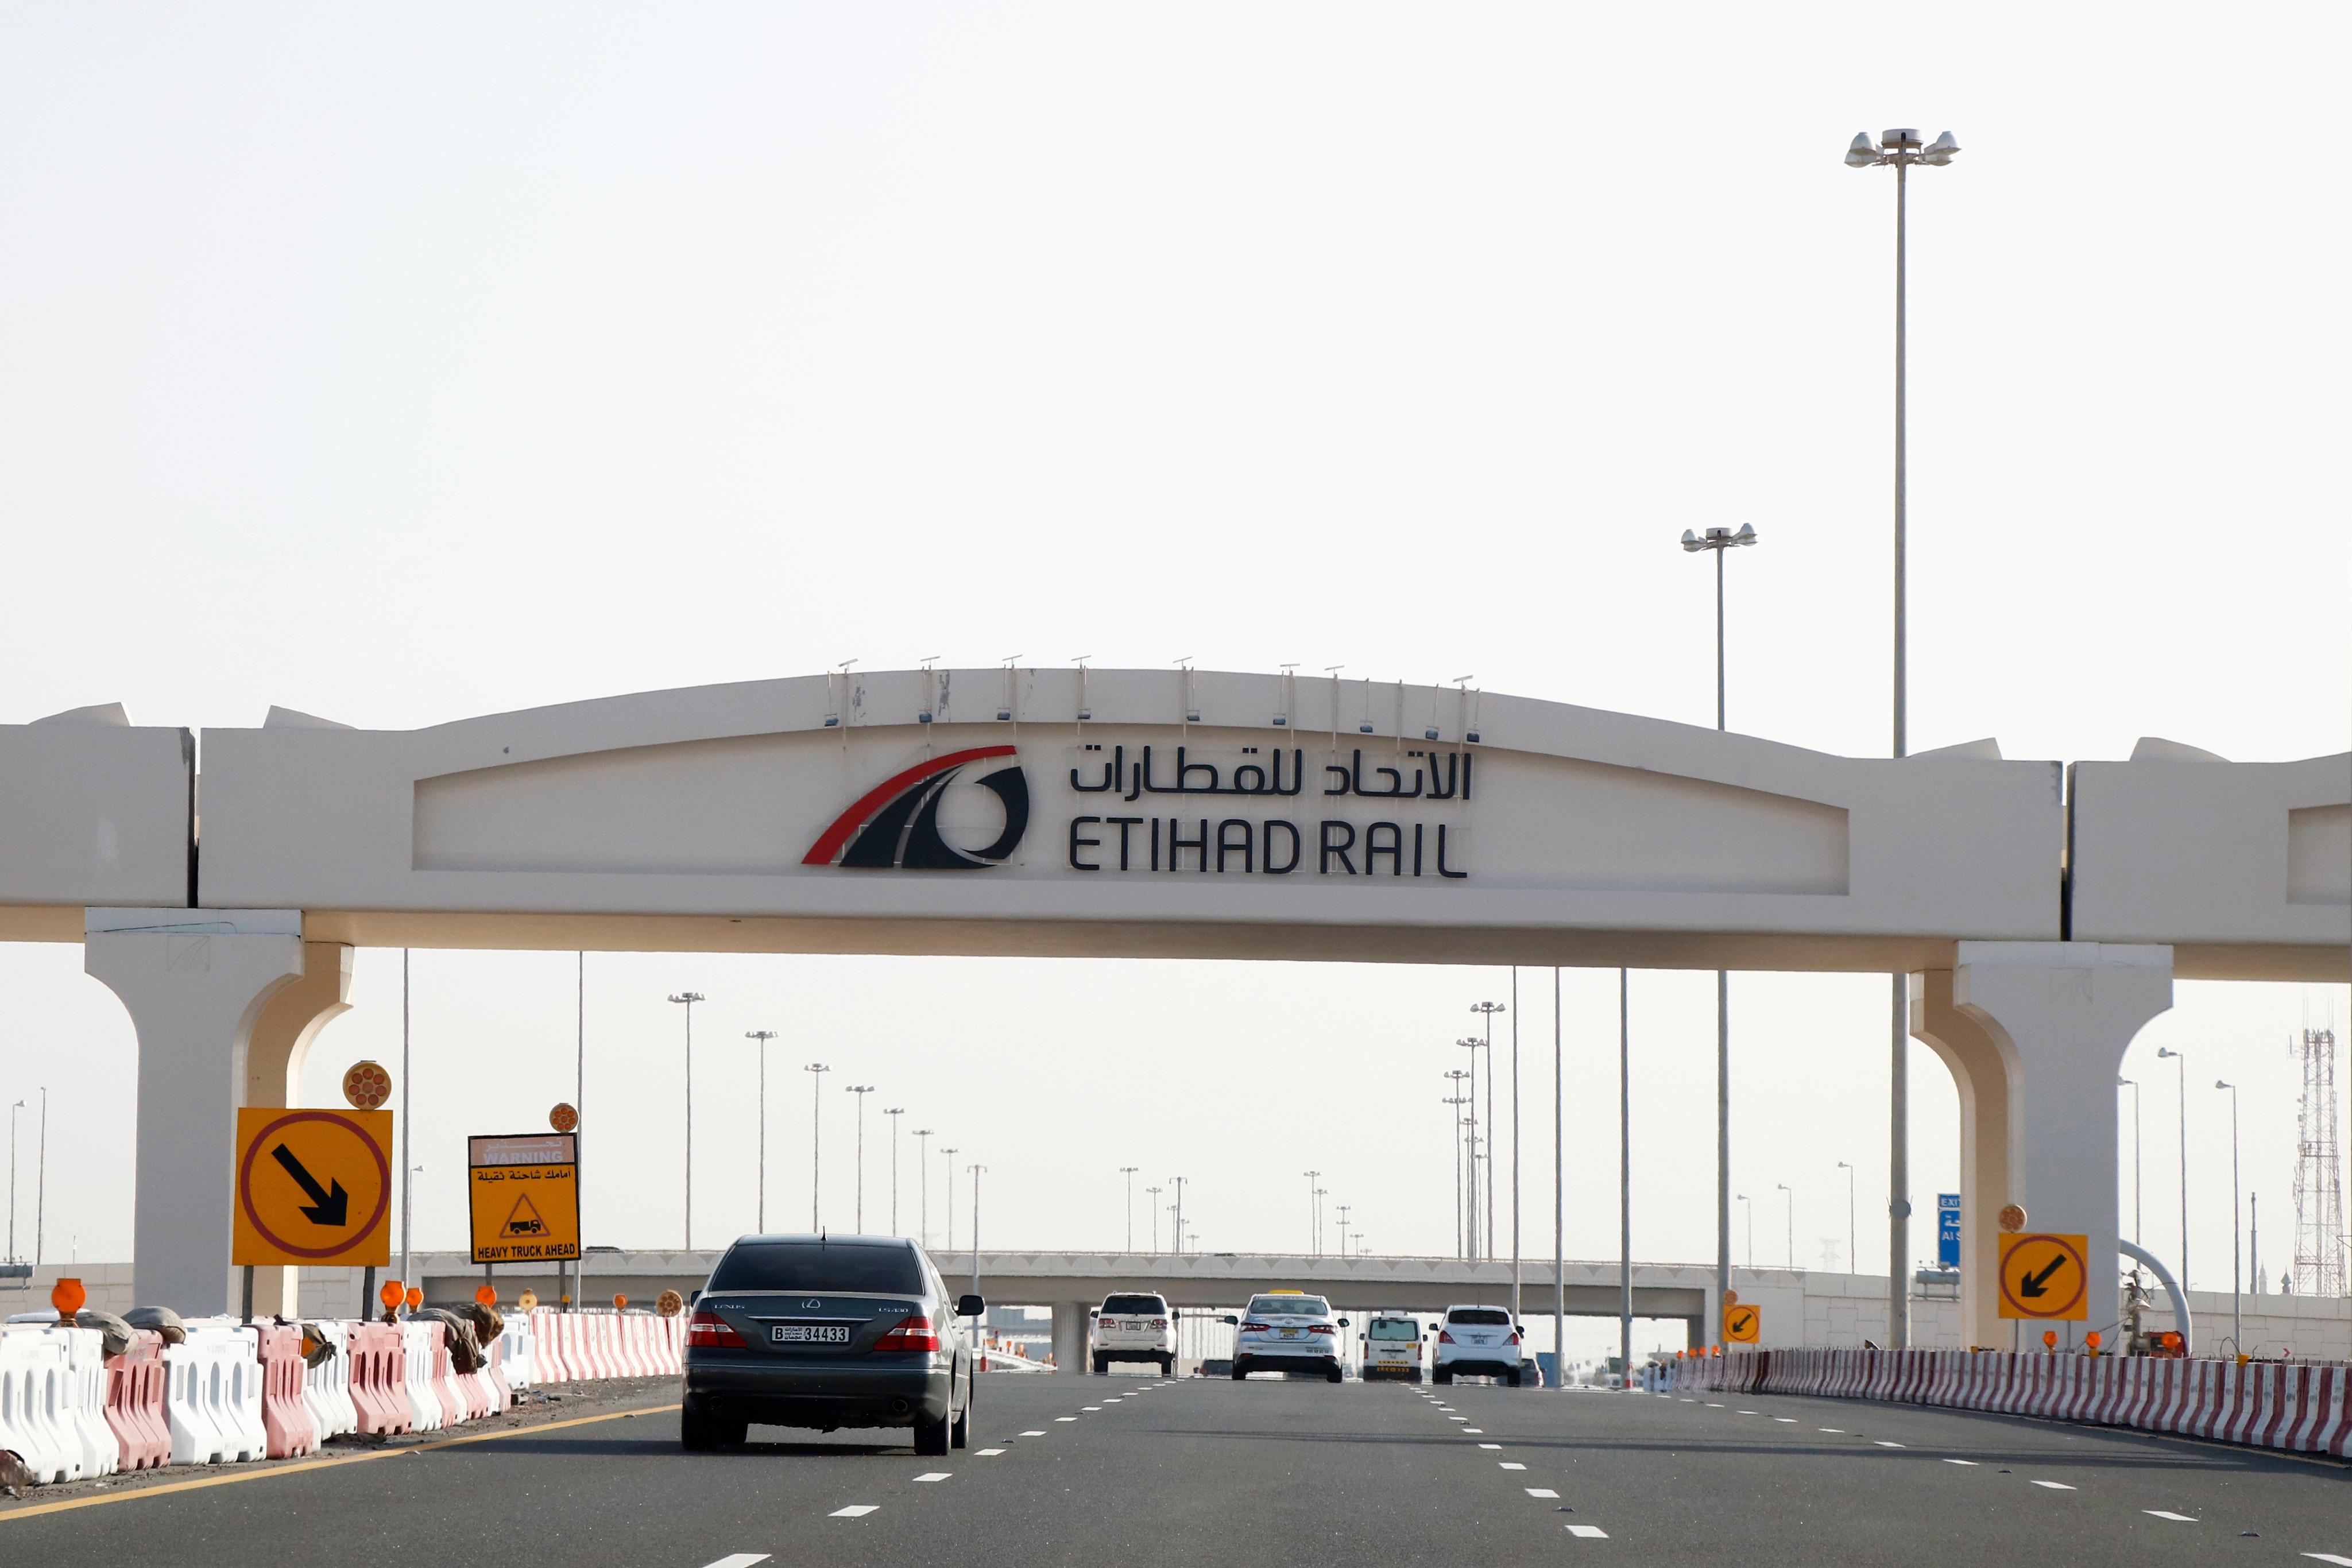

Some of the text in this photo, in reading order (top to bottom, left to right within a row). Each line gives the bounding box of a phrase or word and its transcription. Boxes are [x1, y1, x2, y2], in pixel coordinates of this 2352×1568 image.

[1070, 745, 1471, 802] الاتحاد للقطارات
[1069, 816, 1468, 878] ETIHAD RAIL
[483, 1150, 563, 1165] WARNING
[477, 1171, 505, 1183] ثقيلة
[509, 1170, 541, 1180] شاحنة
[478, 1243, 575, 1259] HEAVY TRUCK AHEAD
[775, 1327, 846, 1341] B 34433
